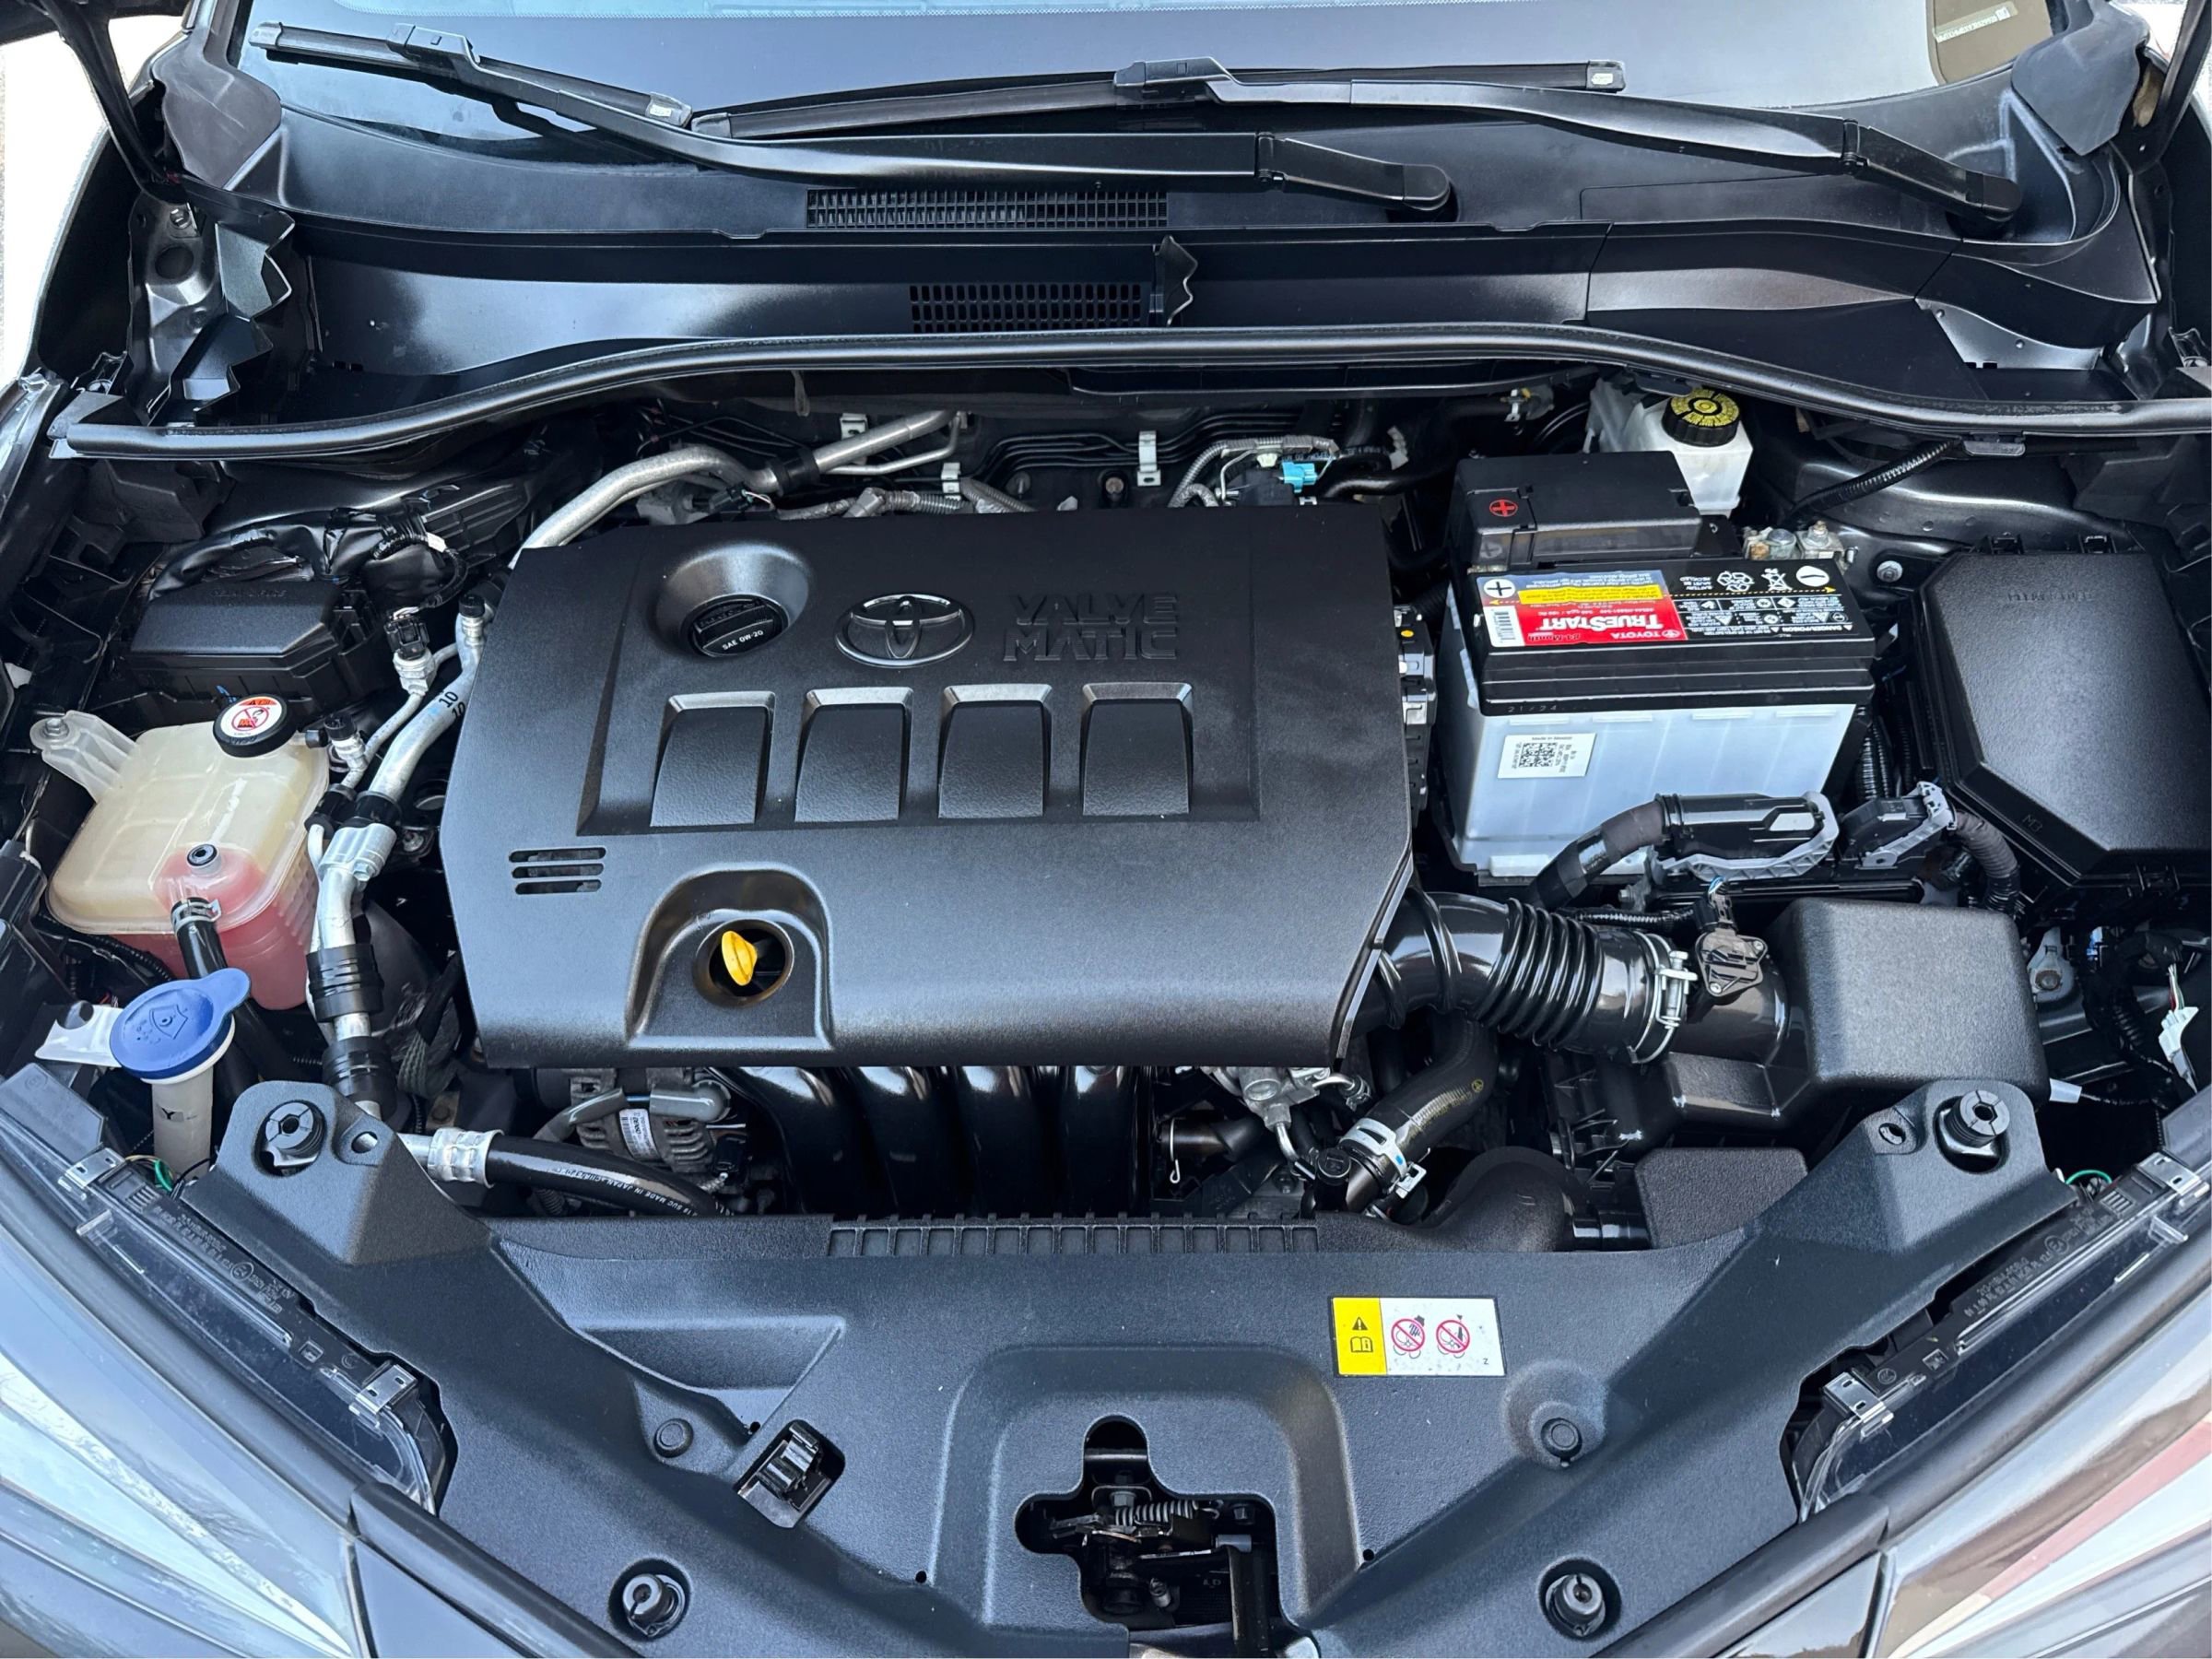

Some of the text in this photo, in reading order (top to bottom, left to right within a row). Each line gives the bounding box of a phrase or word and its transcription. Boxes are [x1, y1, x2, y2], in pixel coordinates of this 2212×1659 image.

[1010, 593, 1178, 627] VALVE
[722, 629, 764, 651] SAE 0W-20
[1611, 631, 1661, 640] TOYOTA
[1004, 628, 1178, 662] MATIC
[439, 691, 459, 708] 10
[606, 1179, 633, 1191] JAPAN
[644, 1191, 666, 1203] MADE
